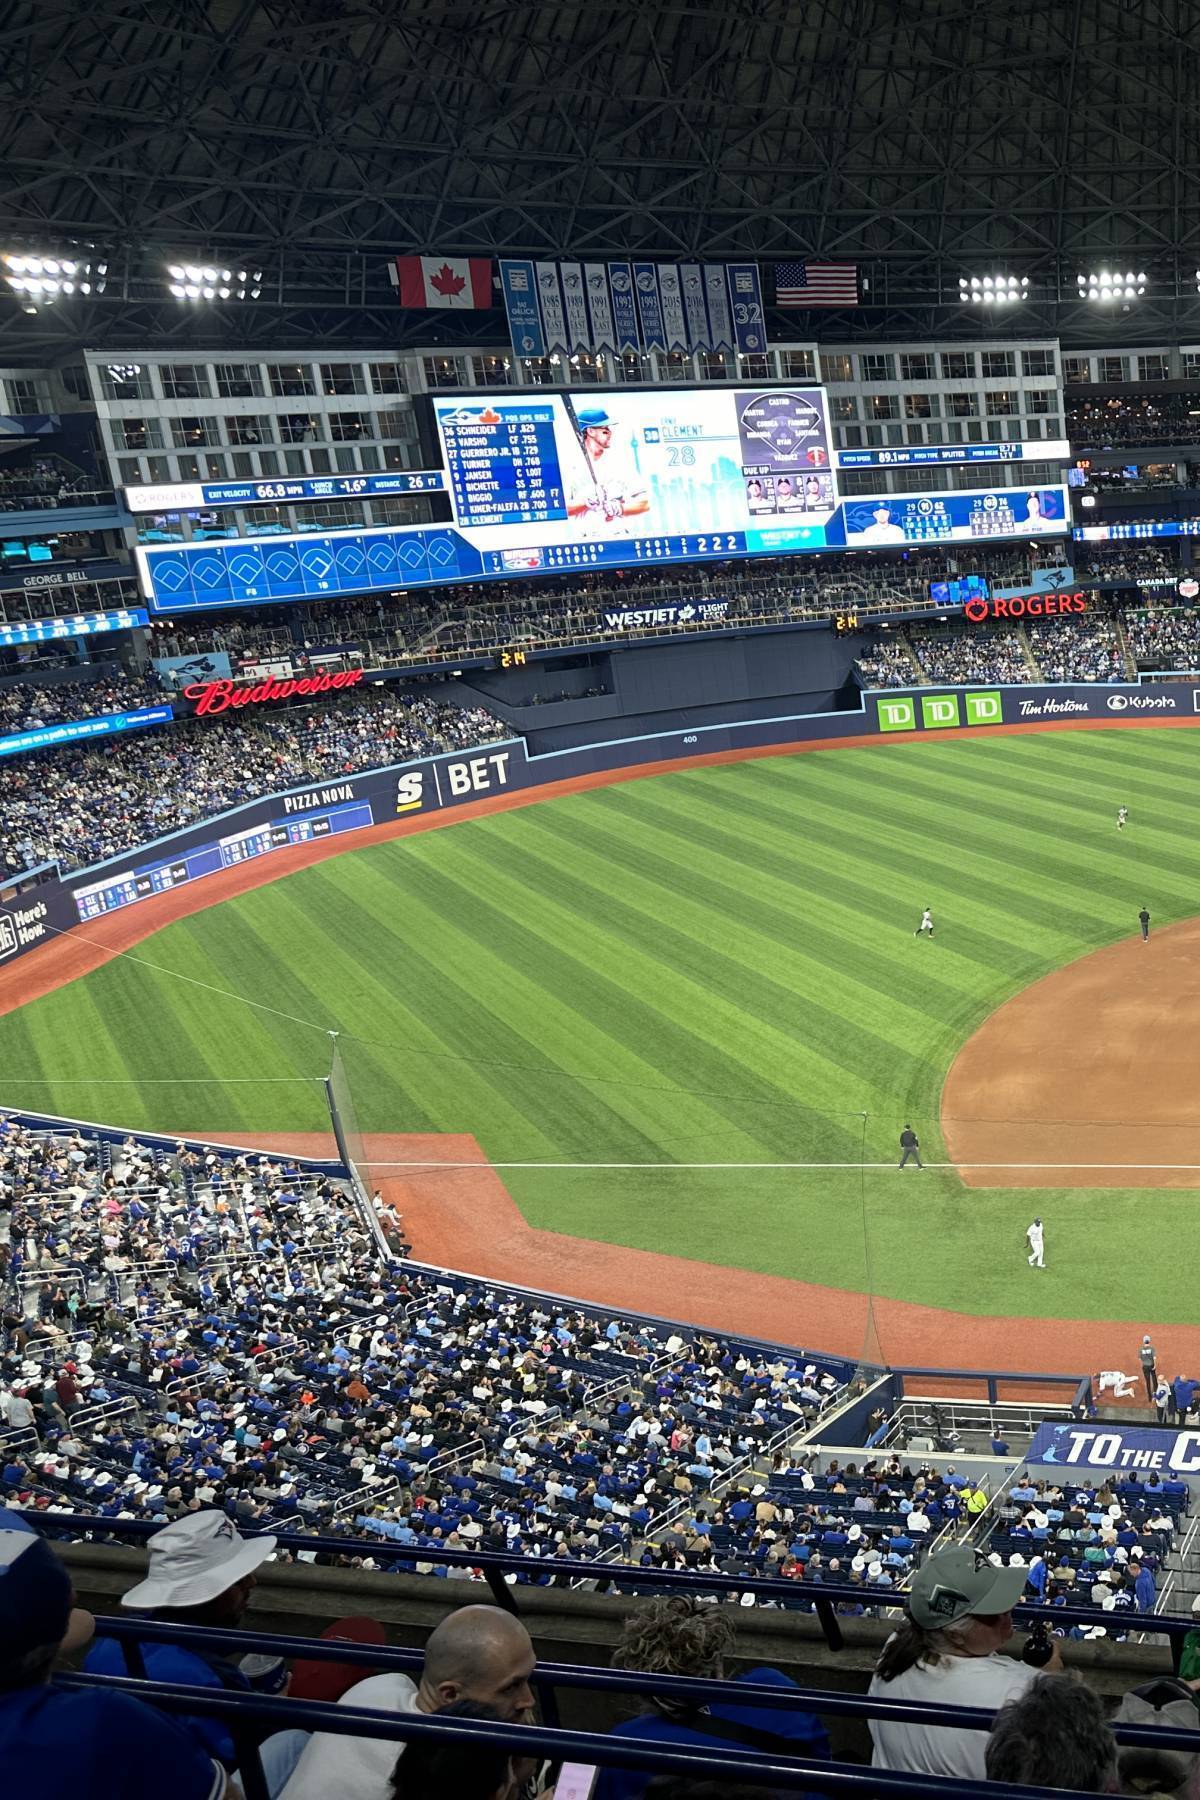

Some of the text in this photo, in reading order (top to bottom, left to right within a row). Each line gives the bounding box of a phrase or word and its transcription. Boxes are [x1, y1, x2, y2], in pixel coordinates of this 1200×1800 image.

[542, 296, 559, 307] 1985
[567, 296, 583, 307] 1989
[590, 296, 607, 308] 1991
[615, 297, 632, 308] 1992
[641, 297, 657, 308] 1993
[735, 303, 761, 324] 32
[444, 424, 535, 436] 36 SCHNEIDER LF .829
[662, 425, 703, 437] CLEMENT
[447, 435, 536, 447] 25 VARSHO CF .755
[448, 446, 538, 459] 27 GUERRERO .729
[666, 446, 695, 466] 28
[878, 452, 897, 463] 89.1
[452, 461, 458, 470] 2
[462, 459, 491, 469] TURNER
[525, 457, 540, 465] .768
[454, 469, 522, 481] 9 JANSEN C
[743, 467, 758, 475] DUE
[408, 476, 436, 488] 26 FT
[466, 479, 542, 491] BICHETTE SS .517
[764, 479, 773, 487] 12
[208, 488, 250, 499] EXIT VELOCITY
[257, 484, 303, 498] 66.8 MPH
[468, 490, 545, 502] BIGGIO RF .600
[531, 500, 546, 509] .700
[934, 502, 944, 510] 62
[974, 500, 982, 508] 29
[472, 515, 502, 524] CLEMENT
[698, 536, 737, 551] 2 2 2
[24, 572, 88, 586] GEORGE BELL
[318, 582, 329, 590] 1B
[698, 603, 728, 613] FLIGHT
[994, 593, 1086, 617] ROGERS
[605, 608, 677, 626] WESTJET
[836, 617, 858, 630] 2:14
[502, 652, 526, 668] 2:14
[184, 667, 364, 715] Budweiser
[970, 698, 999, 718] TD
[1019, 698, 1089, 716] Tim Hortons
[1129, 696, 1176, 708] Kubota
[881, 704, 911, 724] TD
[926, 701, 955, 721] TD
[49, 729, 67, 741] path
[683, 735, 697, 745] 400
[397, 753, 509, 805] S BET
[284, 785, 354, 814] PIZZA NOVA
[14, 901, 47, 928] Here's
[18, 923, 45, 945] How.
[1069, 1431, 1123, 1466] TO
[1121, 1448, 1167, 1469] THE
